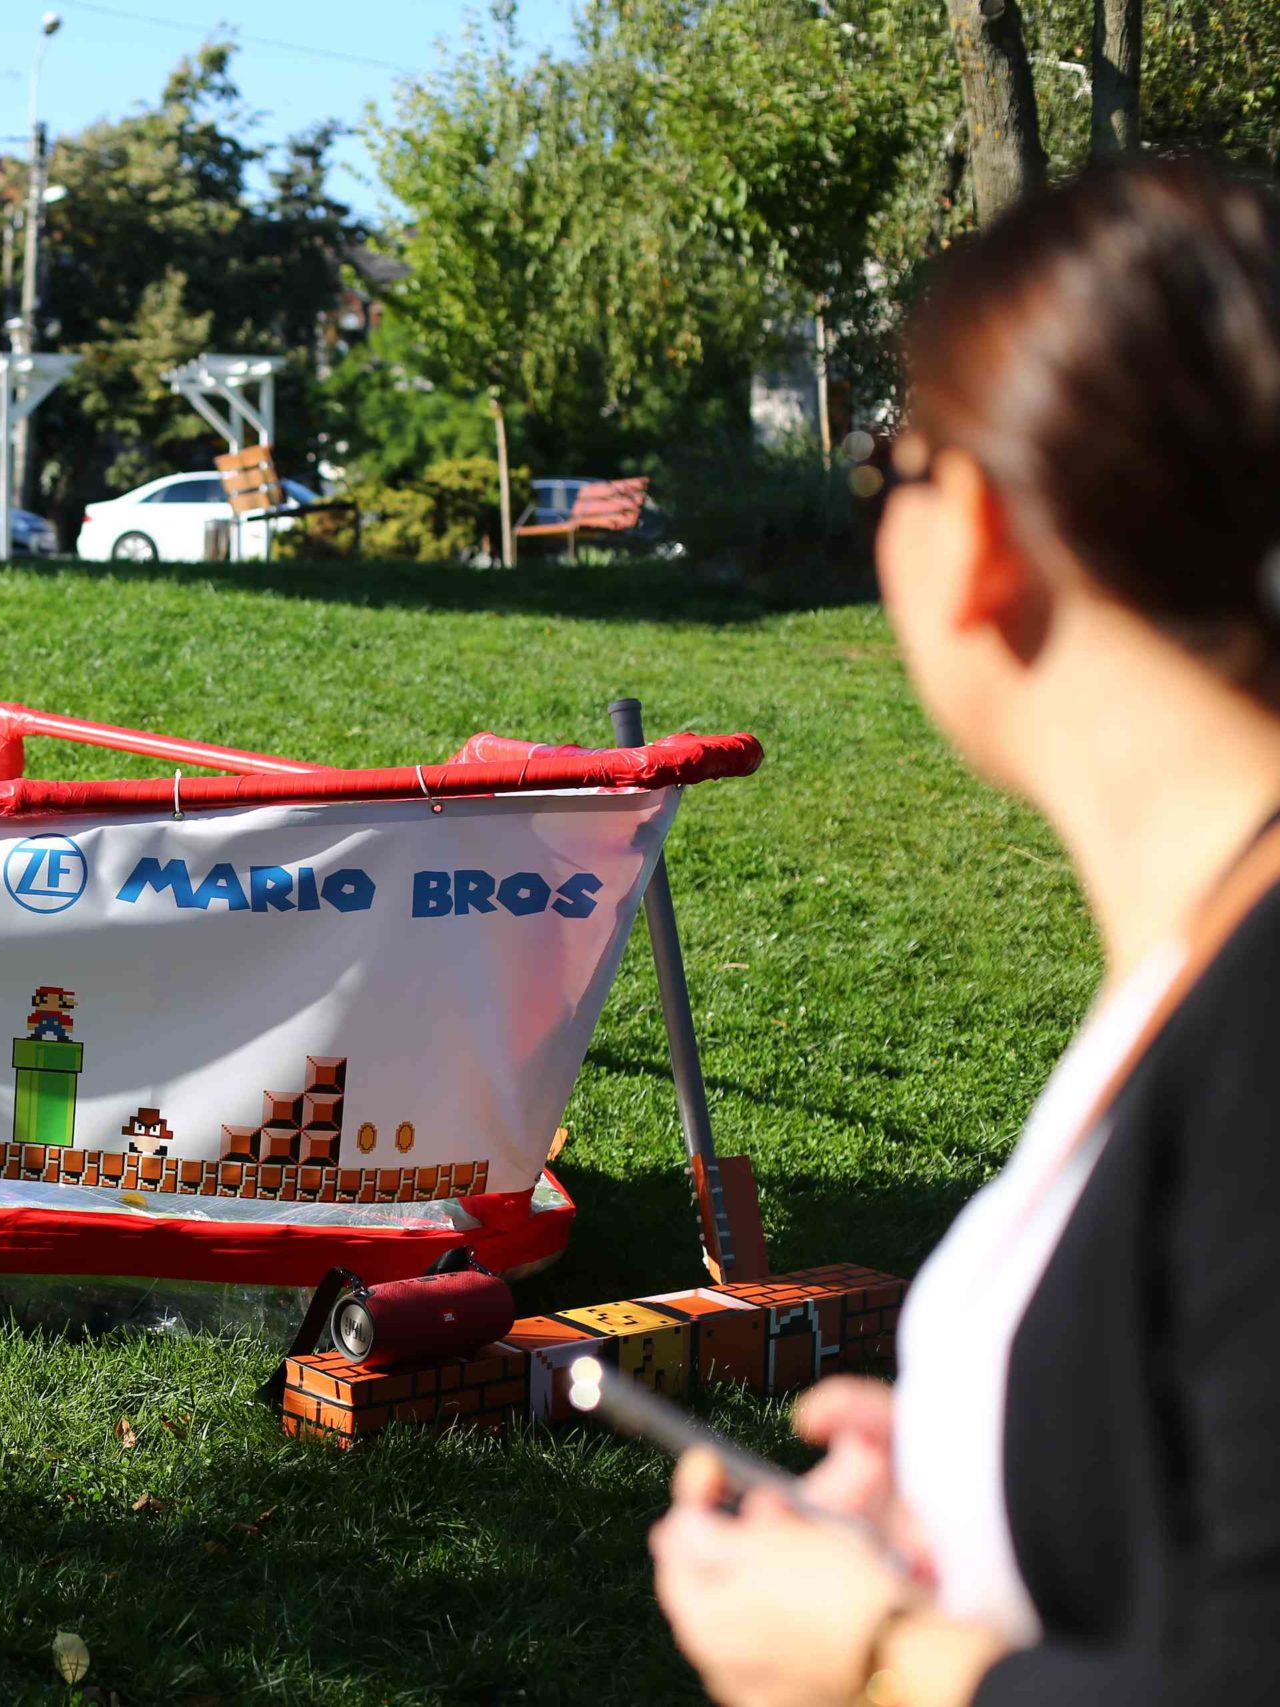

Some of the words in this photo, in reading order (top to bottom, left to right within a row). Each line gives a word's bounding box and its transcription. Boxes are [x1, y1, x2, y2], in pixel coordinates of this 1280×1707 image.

[12, 847, 84, 898] ZF
[116, 857, 377, 912] MARIO
[412, 870, 605, 918] BROS
[344, 1317, 367, 1343] JBL
